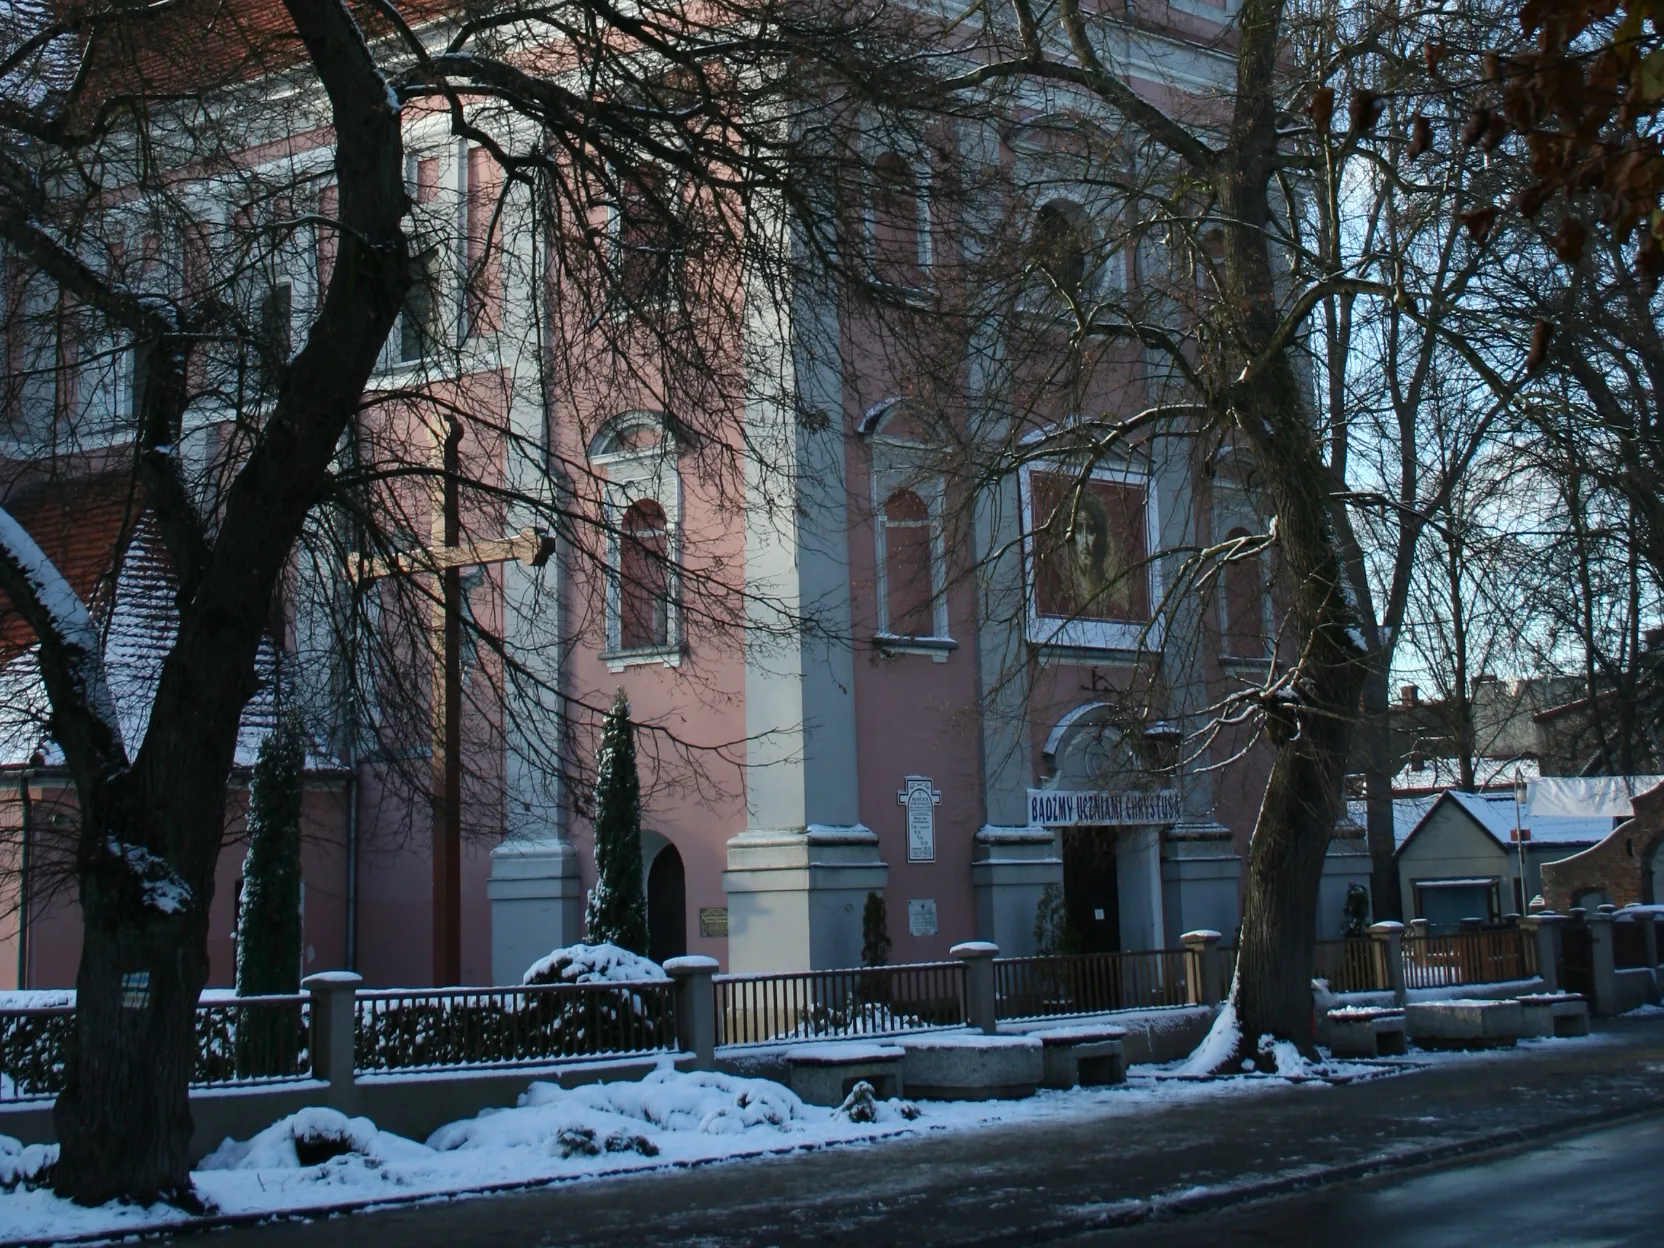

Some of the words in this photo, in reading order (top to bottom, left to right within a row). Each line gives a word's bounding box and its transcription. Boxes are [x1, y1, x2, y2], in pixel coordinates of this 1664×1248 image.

[1032, 794, 1073, 824] BĄDŹMY
[1076, 795, 1123, 821] UCZNIAMI
[1126, 793, 1181, 820] CHRYSTUSA
